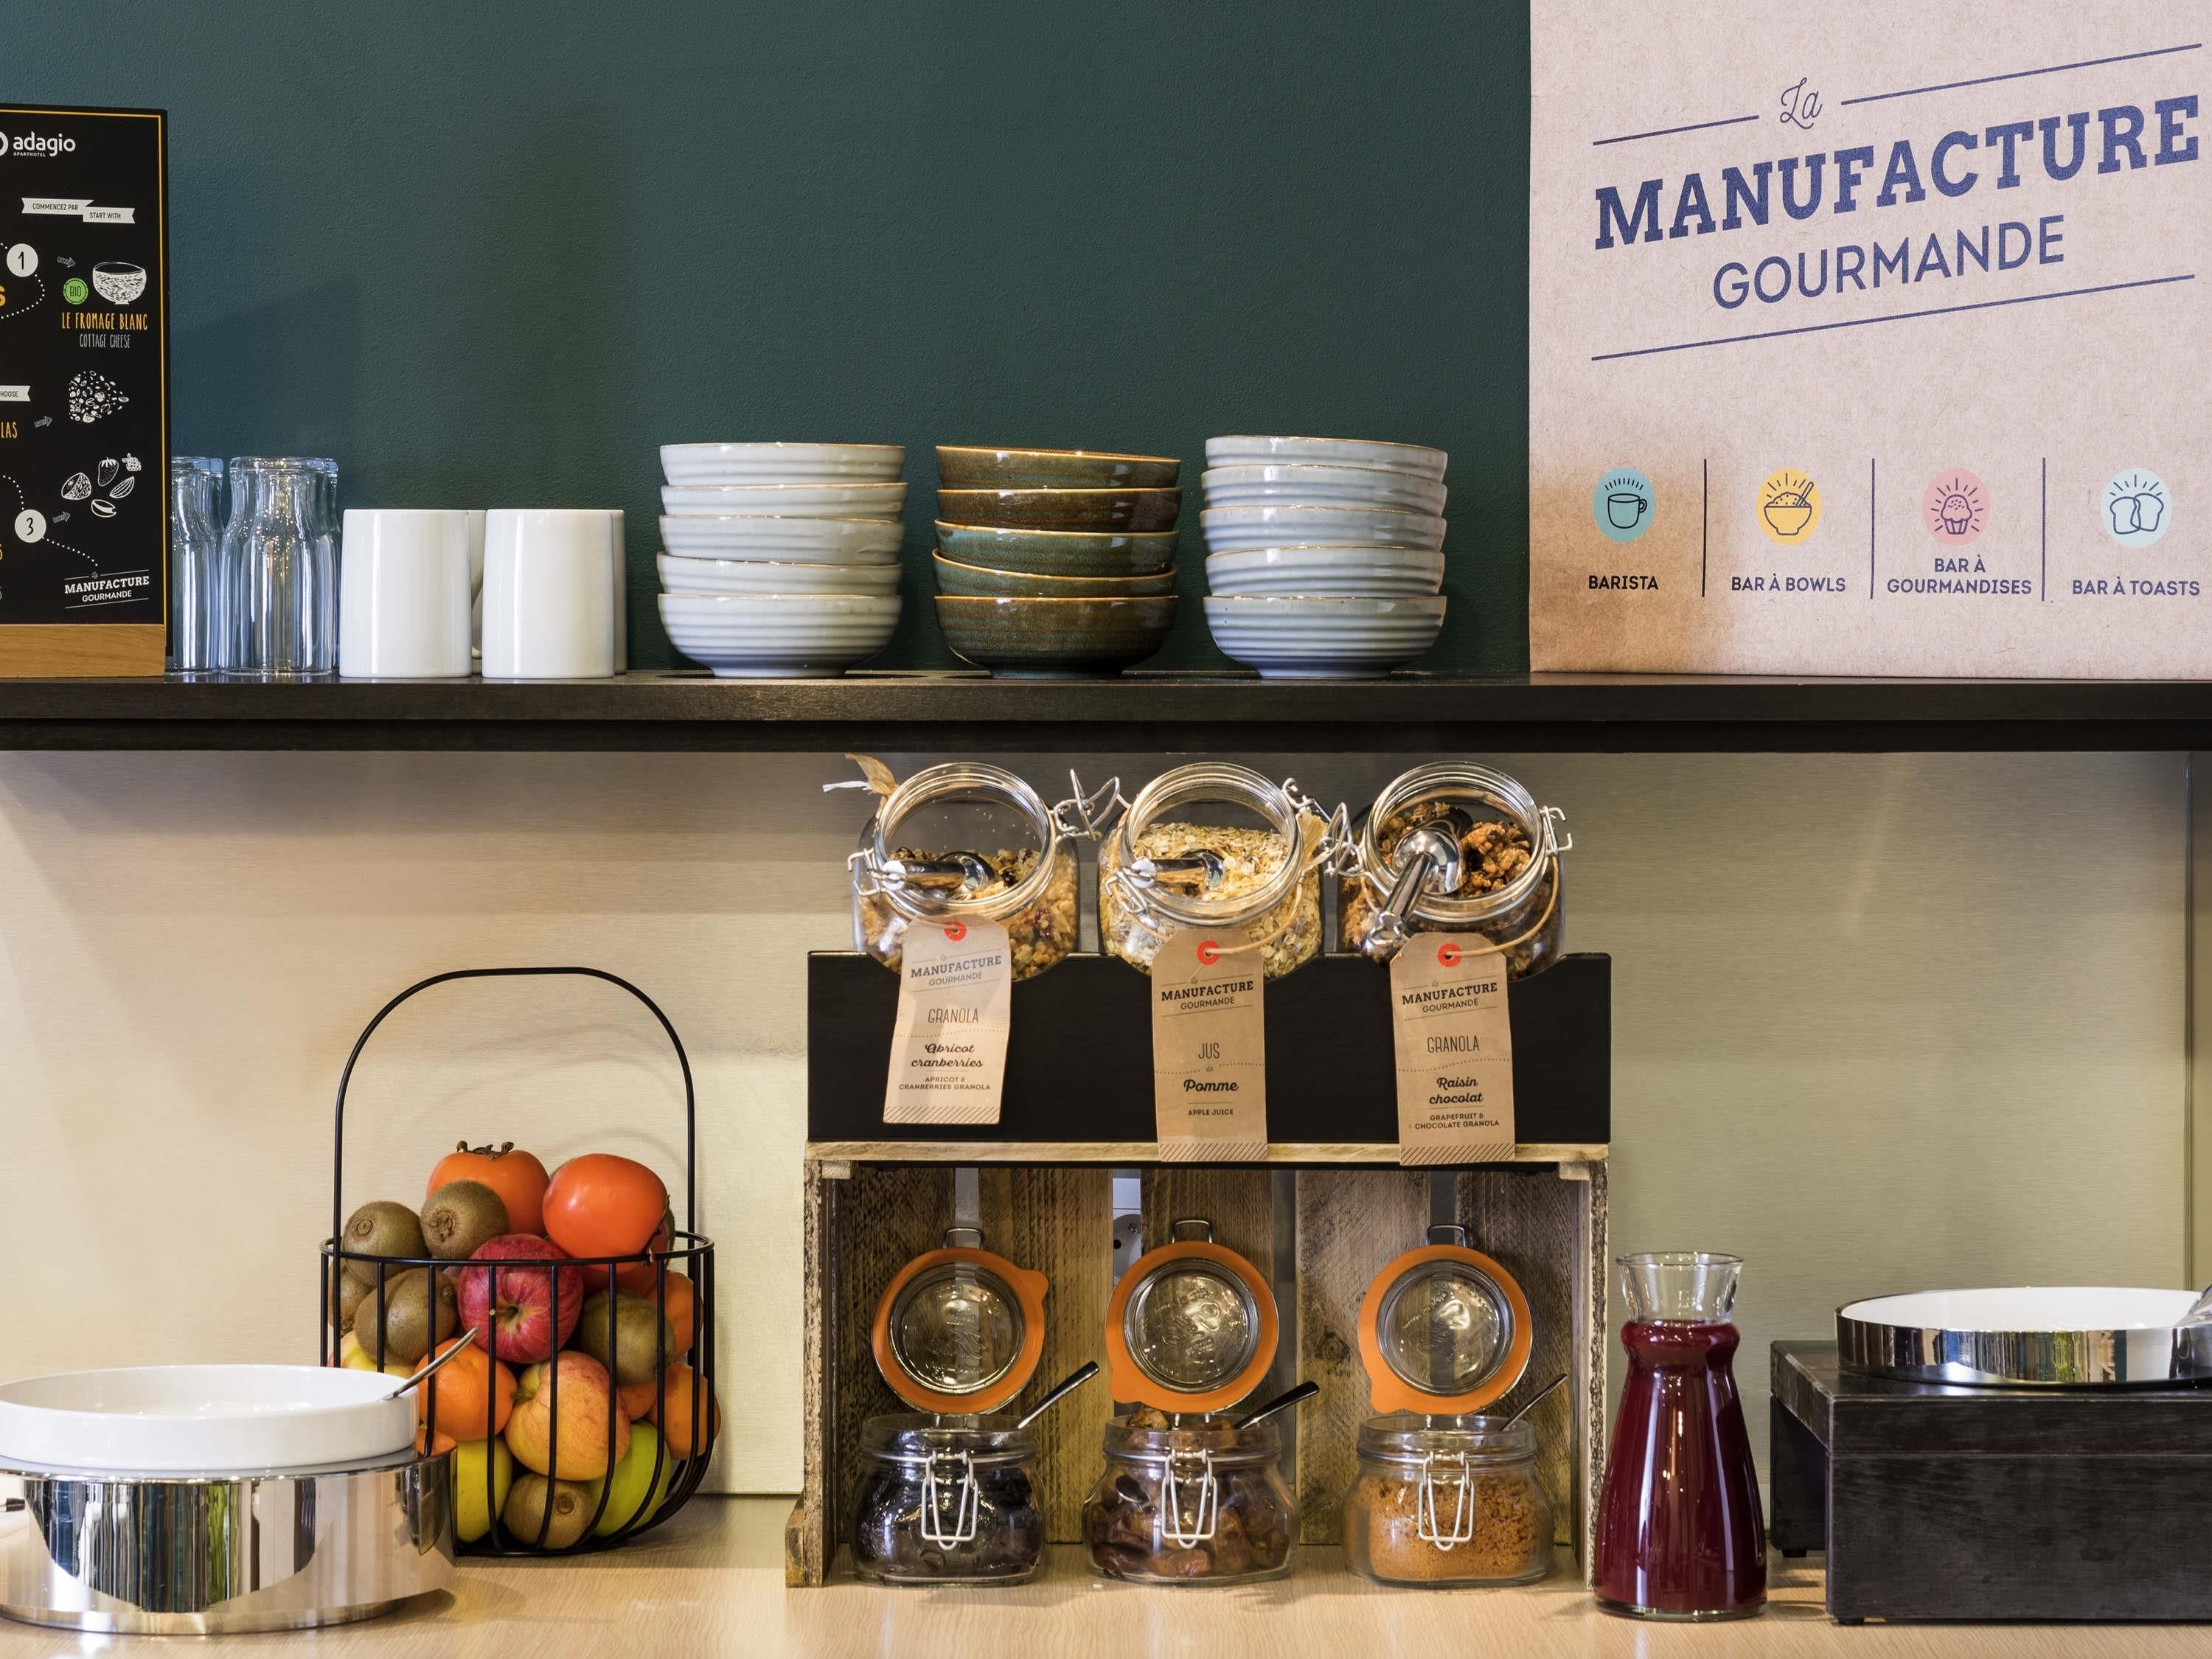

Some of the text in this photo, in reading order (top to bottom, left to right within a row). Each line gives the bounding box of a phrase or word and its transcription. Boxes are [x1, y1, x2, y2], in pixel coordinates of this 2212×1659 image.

[1779, 77, 1823, 130] La
[13, 131, 77, 157] adagio
[1594, 94, 2199, 251] MANUFACTURE
[32, 203, 79, 212] COMMENCEZ PAR
[18, 251, 24, 270] 1
[1712, 214, 2065, 310] GOURMANDE
[69, 285, 82, 298] BIO
[61, 312, 148, 330] LE FROMAGE BLANC
[79, 333, 131, 348] COTTAGE CHEESE
[27, 517, 34, 536] 3
[1934, 554, 1986, 574] BAR À
[64, 576, 150, 594] MANUFACTURE
[1588, 575, 1659, 591] BARISTA
[1731, 571, 1846, 592] BAR À BOWLS
[1887, 579, 2033, 595] GOURMANDISES
[2072, 575, 2200, 597] BAR À TOASTS
[82, 590, 133, 602] GOURMANDE
[911, 955, 1003, 978] MANUFACTURE
[928, 971, 983, 987] GOURMANDE
[1161, 980, 1254, 1001] MANUFACTURE
[1402, 982, 1498, 1005] MANUFACTURE
[1180, 996, 1235, 1010] GOURMANDE
[1422, 998, 1479, 1013] GOURMANDE
[927, 1008, 979, 1024] GRANOLA
[925, 1043, 975, 1054] Abricot
[1197, 1042, 1220, 1060] JUS
[1427, 1034, 1480, 1054] GRANOLA
[911, 1057, 984, 1068] cranberries
[1183, 1079, 1239, 1092] Pomme
[1436, 1077, 1478, 1090] Raisin
[1429, 1092, 1484, 1105] chocolat
[1415, 1119, 1500, 1130] CHOCOLATE GRANOLA
[1430, 1113, 1476, 1121] GRAPEFRUIT
